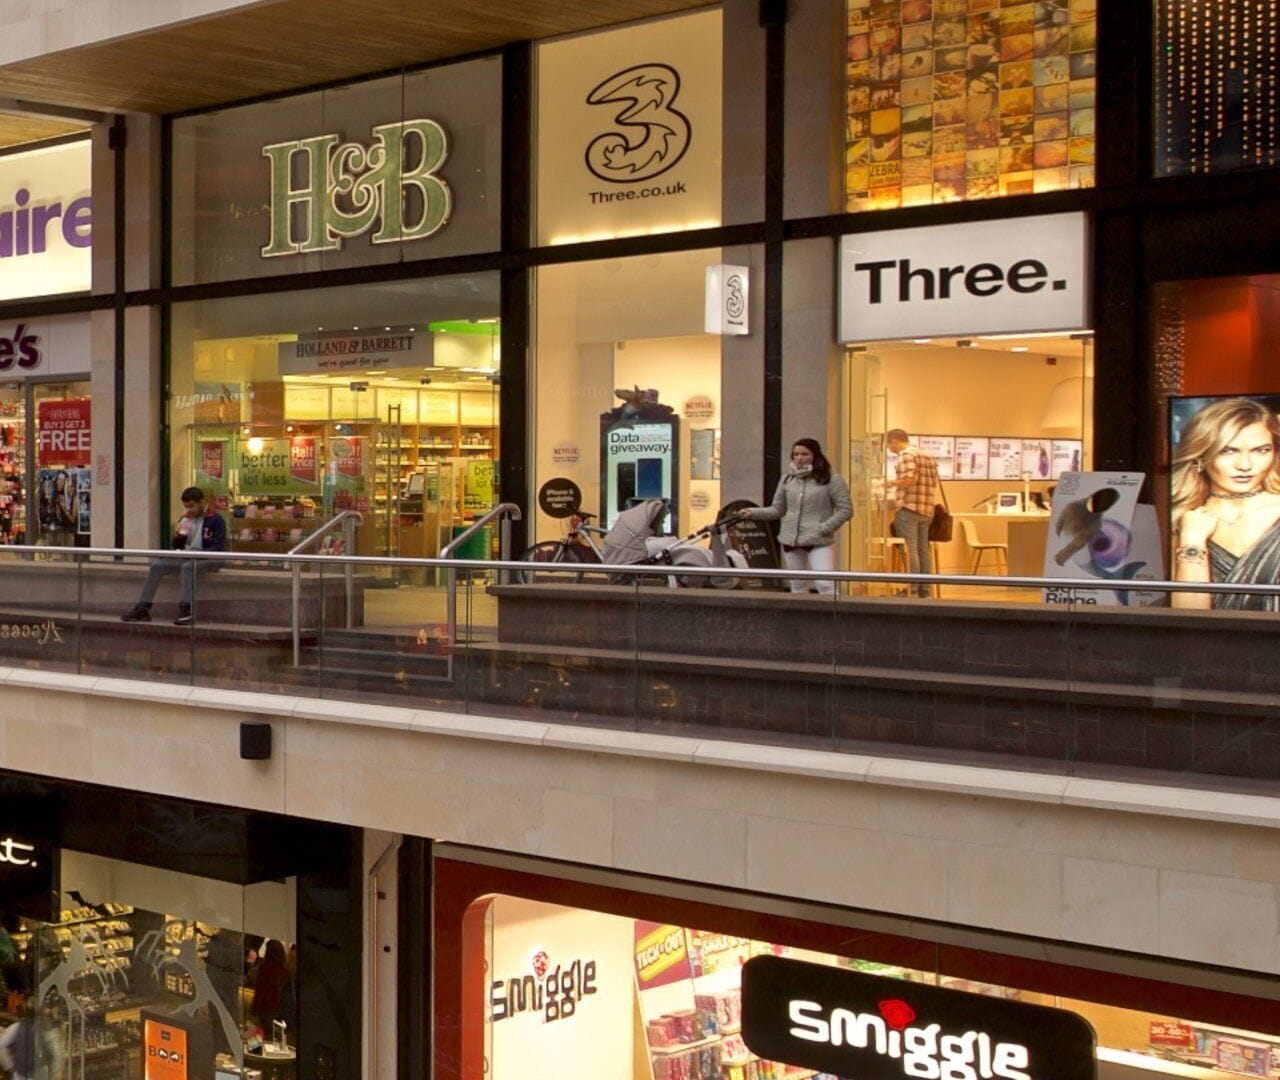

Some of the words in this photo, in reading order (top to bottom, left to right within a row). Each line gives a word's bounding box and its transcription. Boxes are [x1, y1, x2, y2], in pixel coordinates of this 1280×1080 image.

[869, 162, 900, 178] ZEBRA
[261, 118, 453, 258] H&B
[589, 182, 687, 205] Three.co.uk
[854, 259, 1067, 304] Three.
[296, 340, 347, 358] HOLLAND
[348, 339, 359, 354] &
[361, 335, 415, 353] BARRETT
[44, 421, 58, 430] BUY
[65, 421, 80, 429] GET
[39, 430, 90, 451] FREE
[611, 432, 639, 443] Data
[291, 446, 314, 458] Half
[610, 443, 672, 455] giveaway.
[242, 453, 288, 467] better
[291, 459, 314, 467] Price
[244, 473, 258, 486] lot
[263, 473, 287, 486] less
[490, 956, 597, 1023] smiggle
[788, 999, 1031, 1080] smiggle
